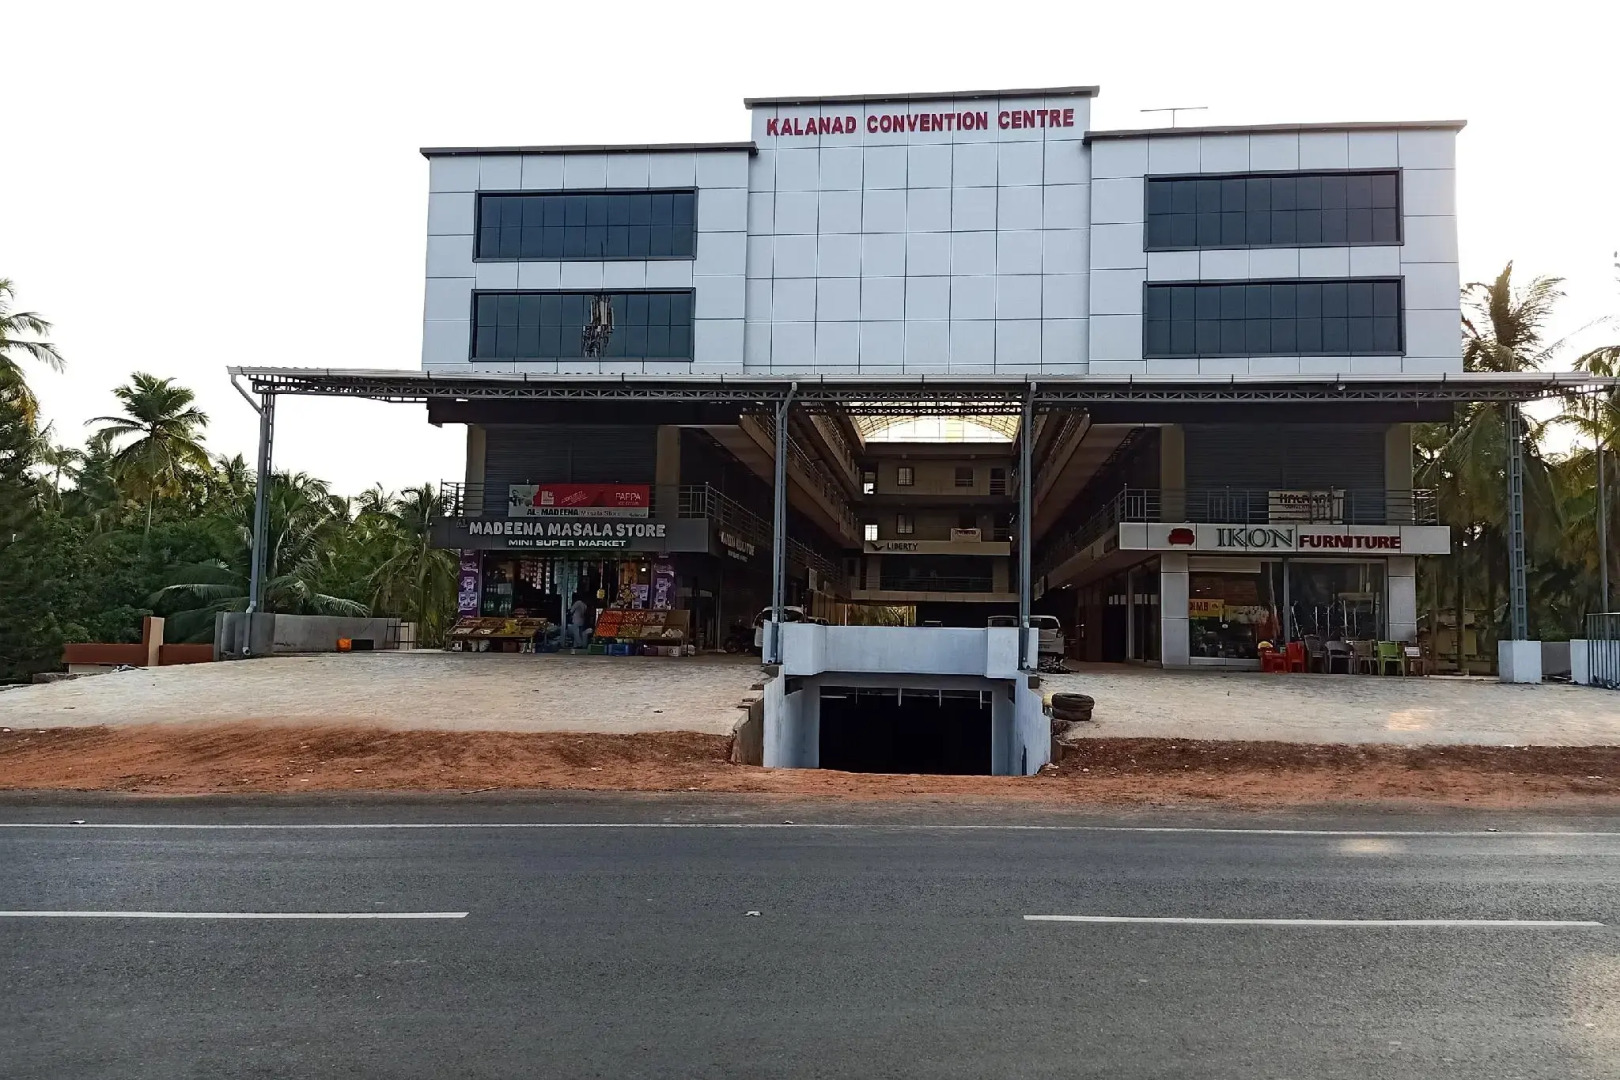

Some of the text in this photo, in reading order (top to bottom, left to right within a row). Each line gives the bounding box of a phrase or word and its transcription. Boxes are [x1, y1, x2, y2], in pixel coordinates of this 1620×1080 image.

[766, 108, 1075, 137] KALANAD CONVENTION CENTRE
[541, 508, 579, 516] MADEENA
[469, 521, 544, 536] MADEENA
[547, 522, 613, 537] MASALA
[616, 523, 666, 538] STORE
[536, 539, 574, 547] SUPER
[1216, 528, 1401, 549] IKON FURNITURE
[887, 543, 918, 551] LIBERTY
